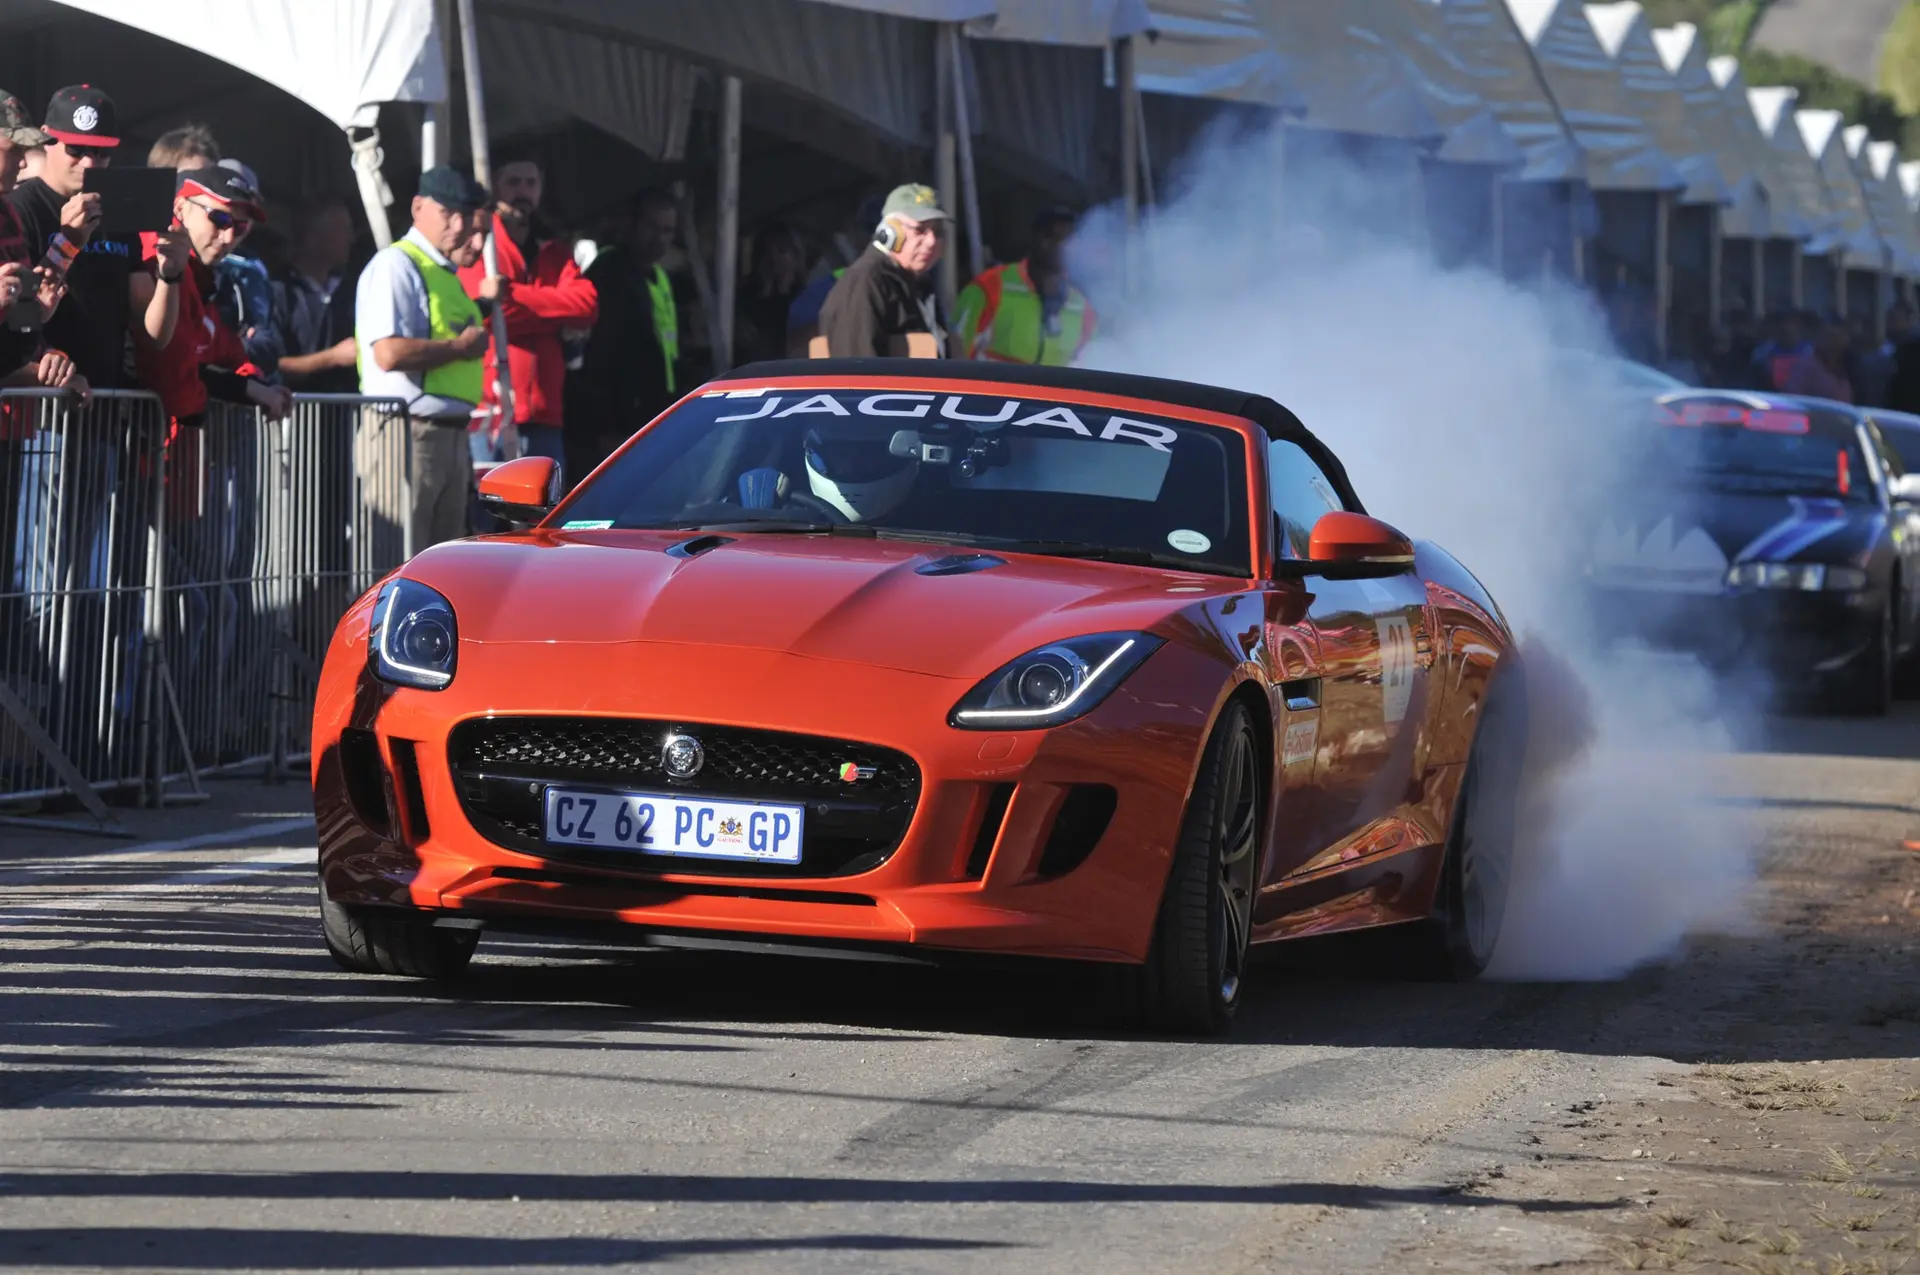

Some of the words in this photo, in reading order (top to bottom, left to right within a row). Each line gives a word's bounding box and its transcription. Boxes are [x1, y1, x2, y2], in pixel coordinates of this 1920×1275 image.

[715, 393, 1178, 454] JAGUAR
[556, 796, 598, 839] CZ
[615, 801, 655, 844] 62
[675, 805, 715, 848] PC
[749, 811, 791, 853] GP
